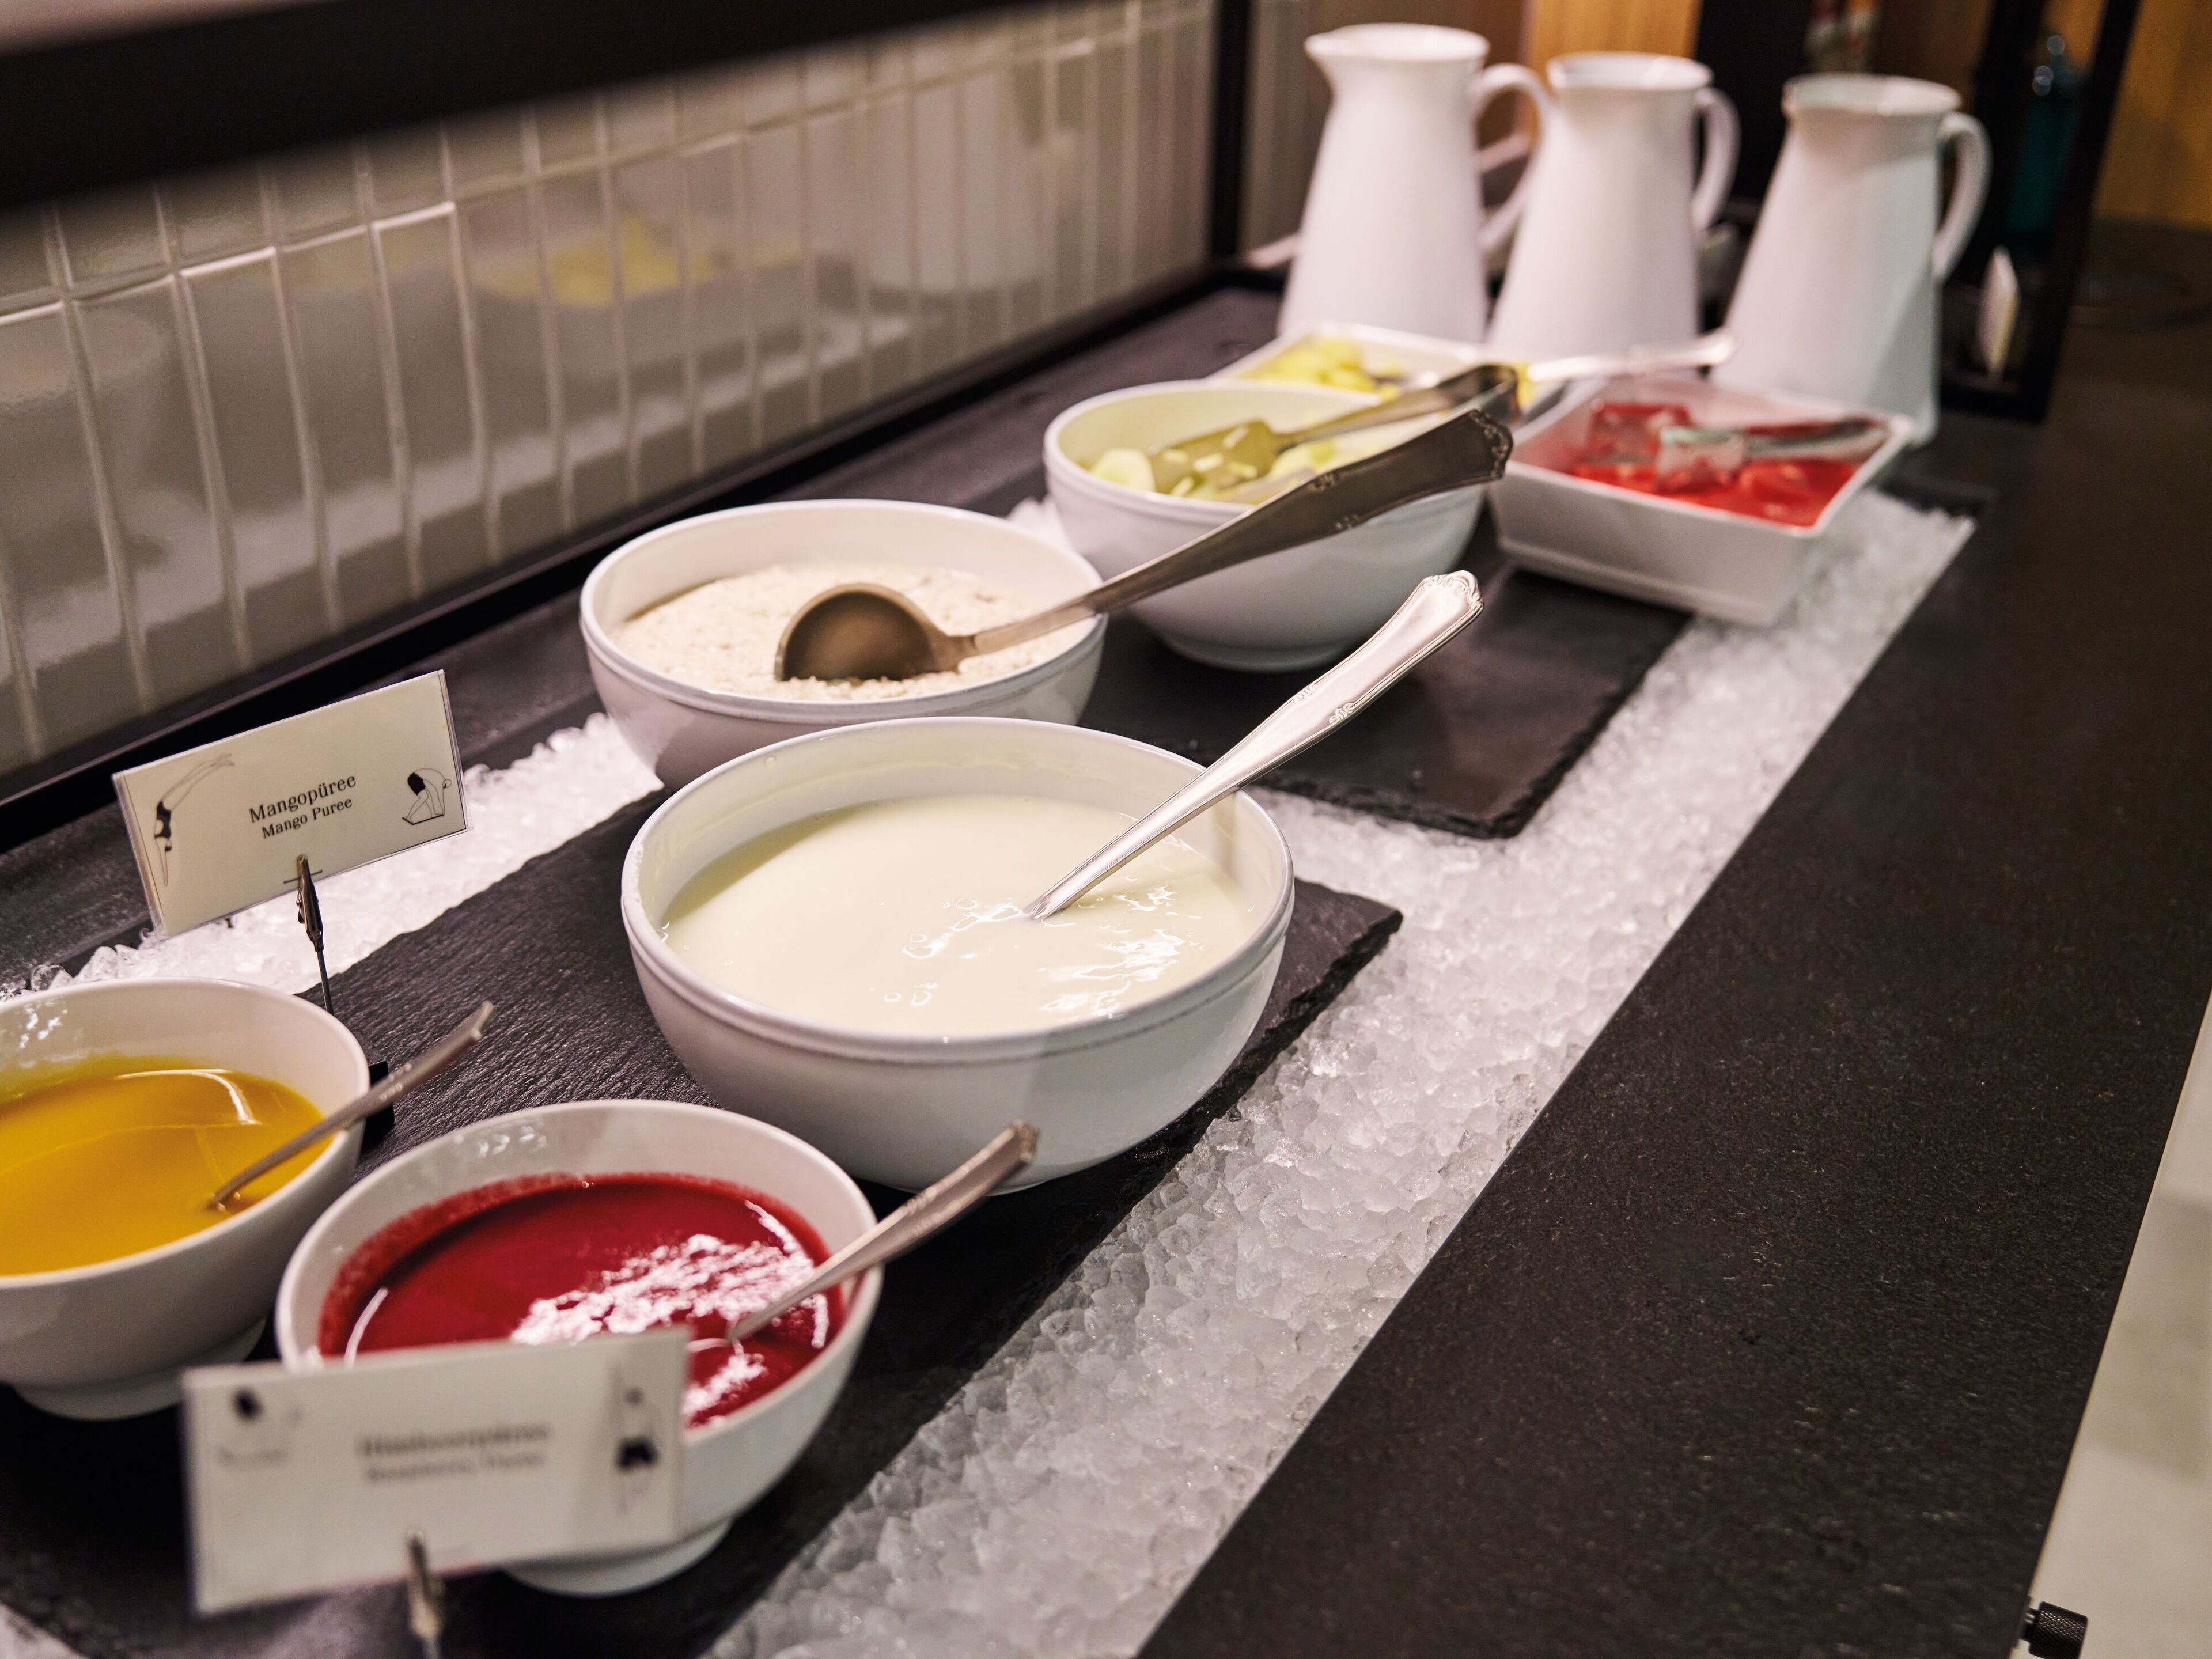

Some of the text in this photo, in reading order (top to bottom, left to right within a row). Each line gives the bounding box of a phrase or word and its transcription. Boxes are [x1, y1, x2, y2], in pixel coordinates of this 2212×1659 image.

[249, 775, 357, 823] Mangopüree
[262, 798, 353, 839] Mango Puree
